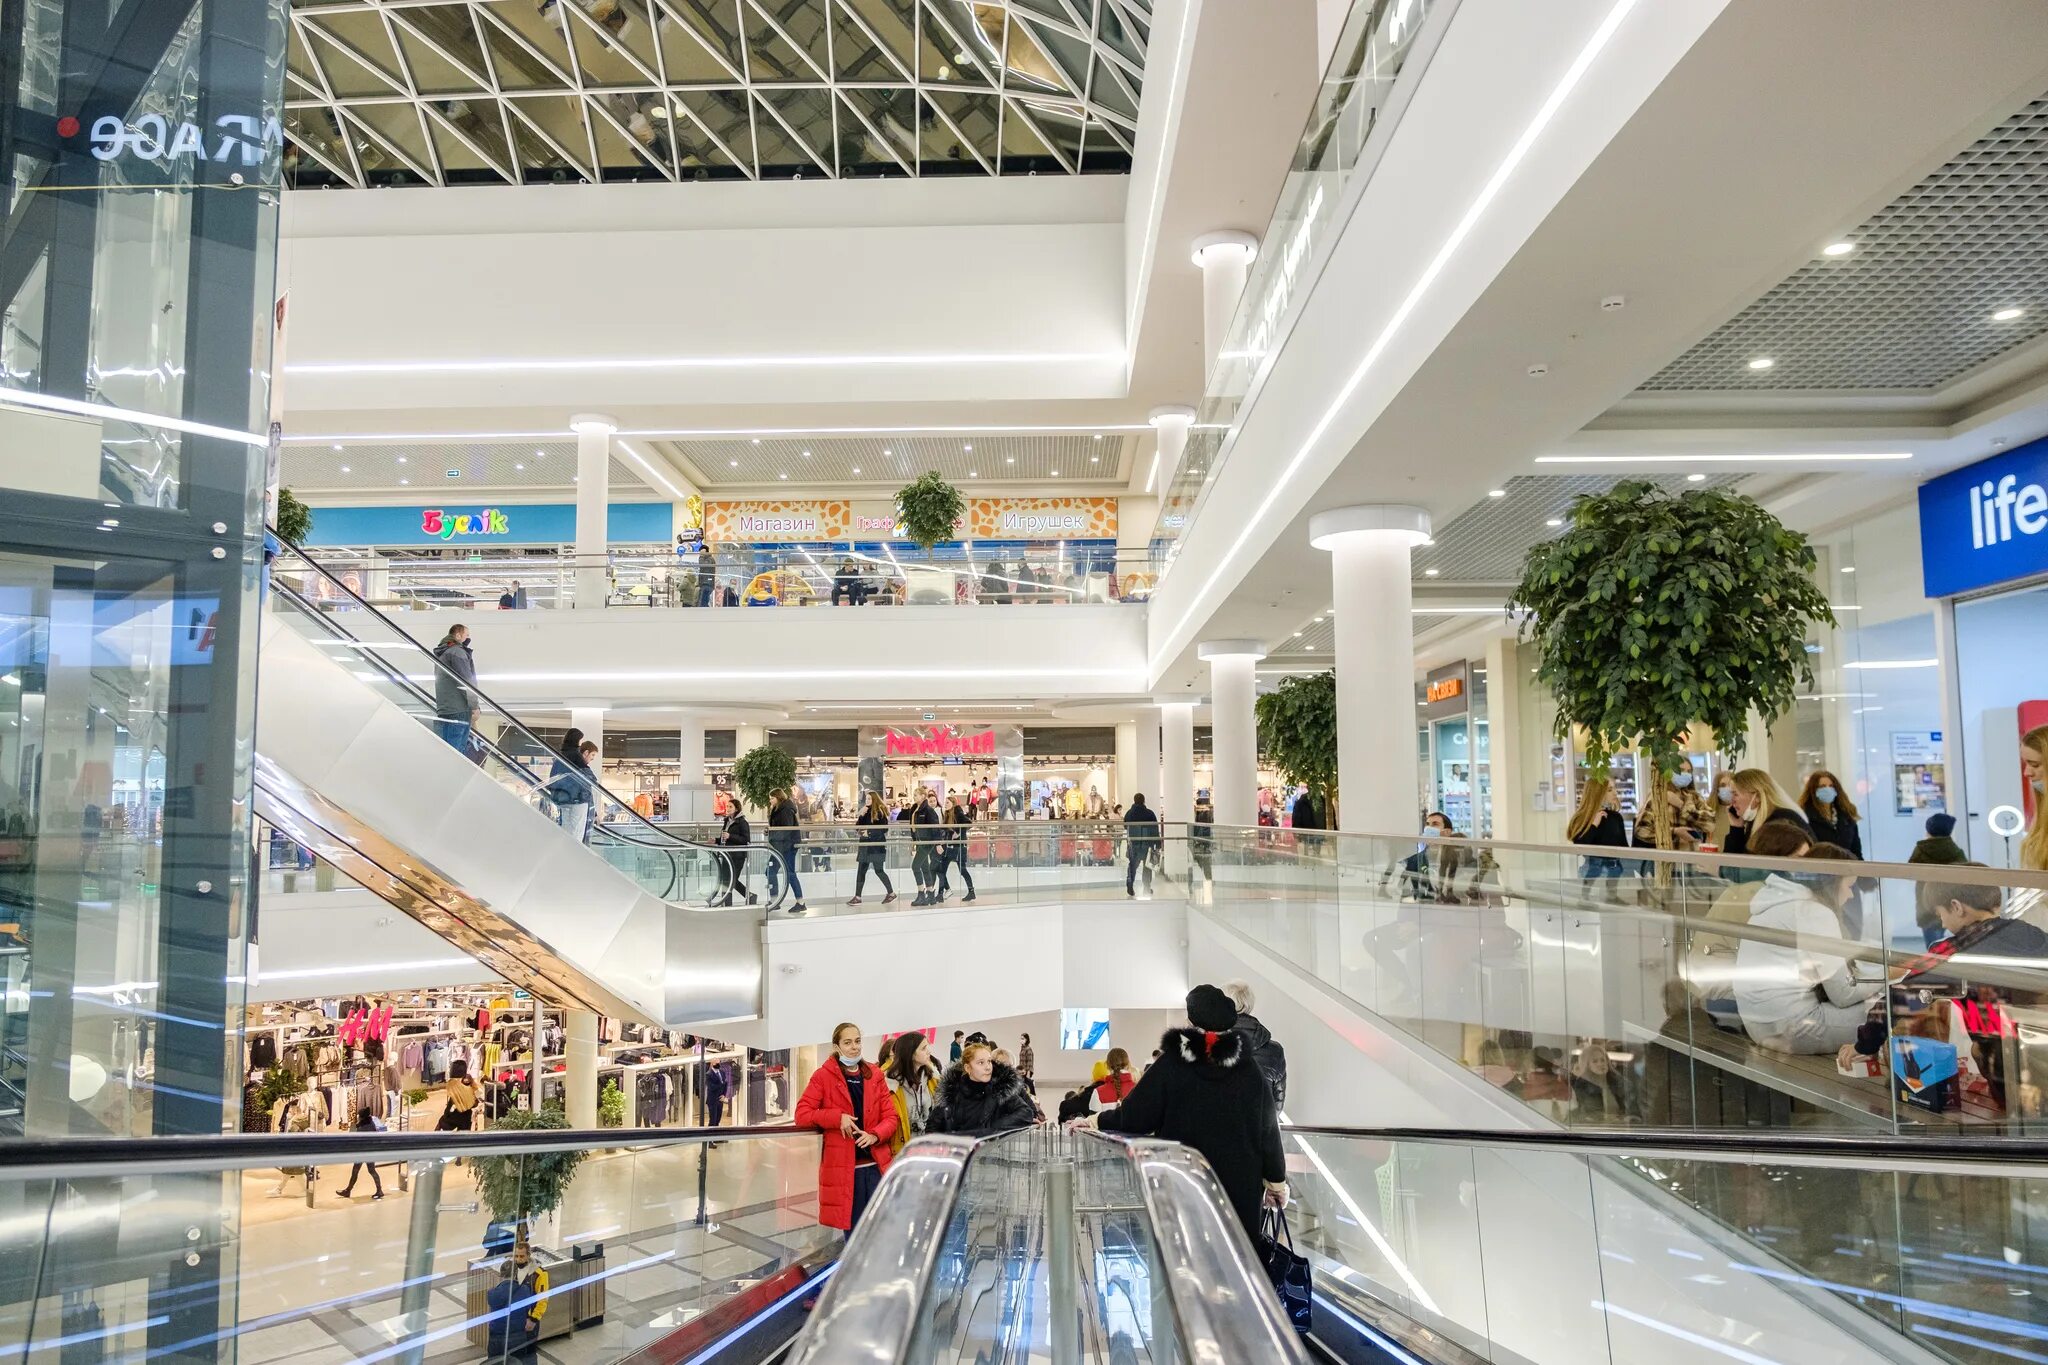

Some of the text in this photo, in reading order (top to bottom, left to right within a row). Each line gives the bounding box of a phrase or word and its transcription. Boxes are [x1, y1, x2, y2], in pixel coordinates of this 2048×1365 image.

[740, 516, 816, 532] Магазин
[1004, 513, 1085, 533] Игрушек
[1969, 473, 2048, 551] life
[337, 1004, 394, 1047] H&M
